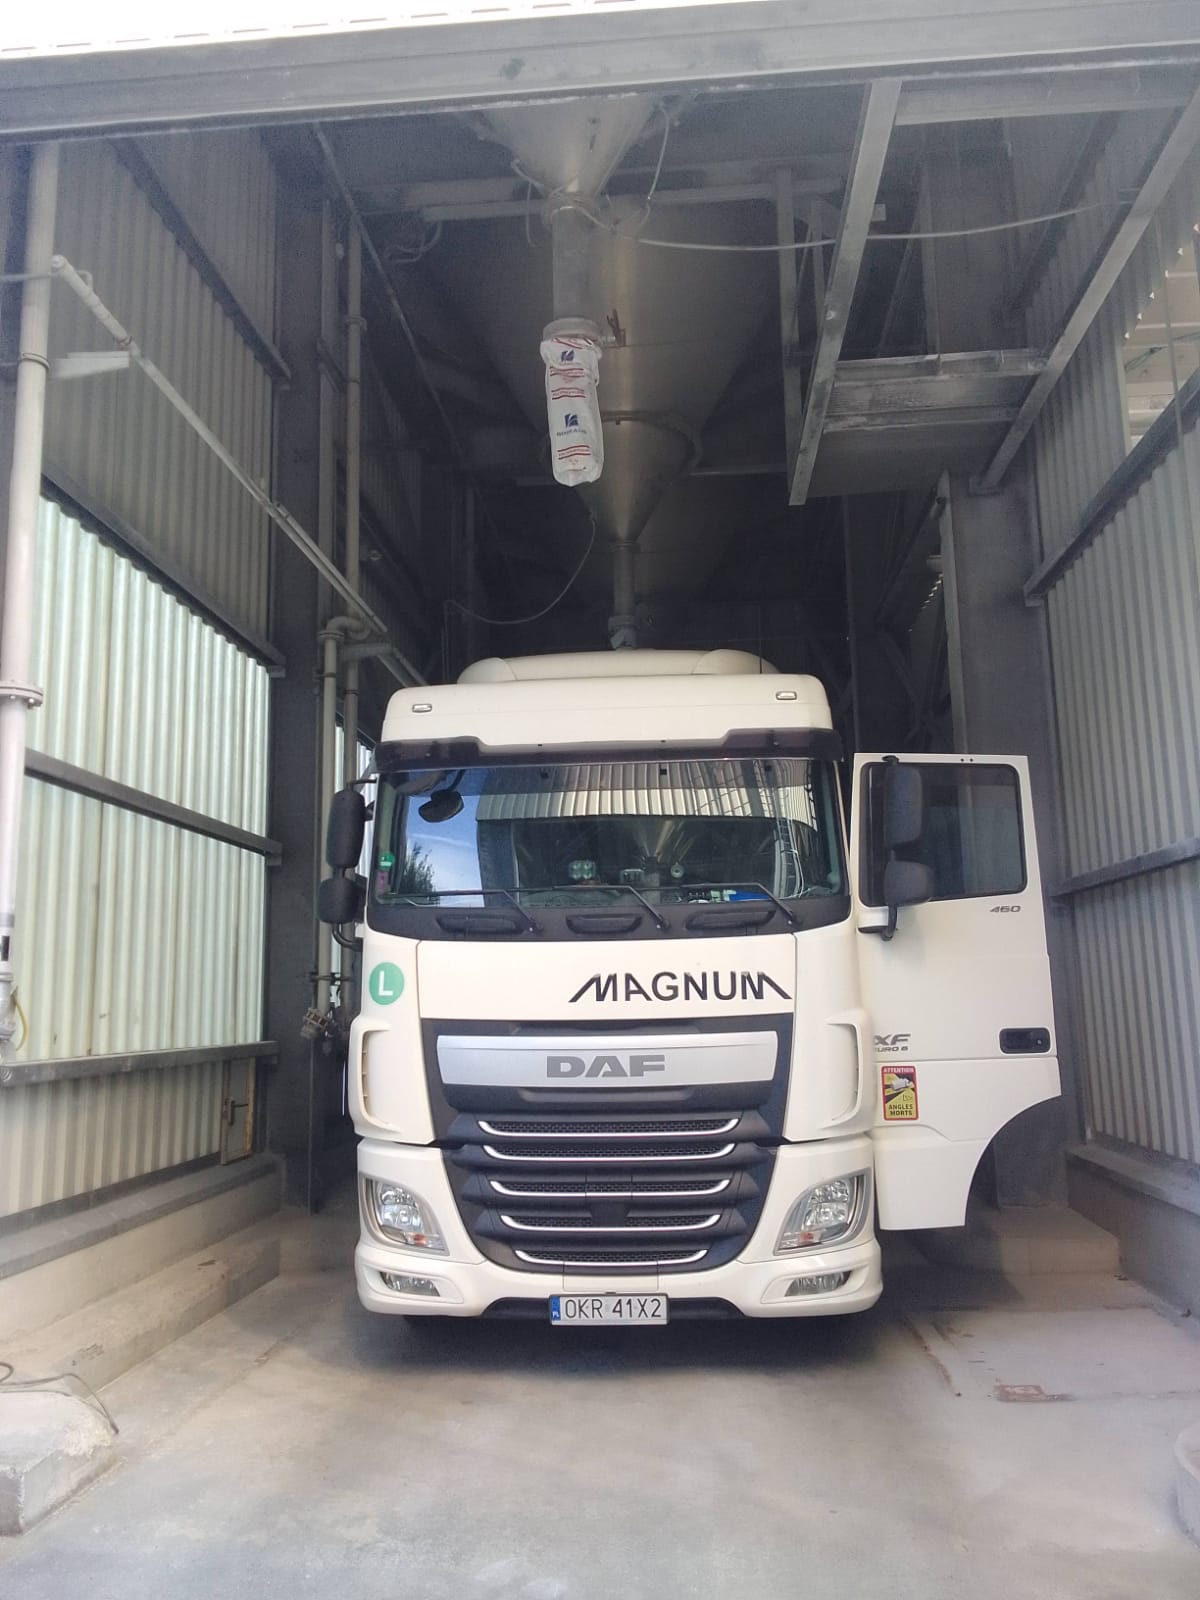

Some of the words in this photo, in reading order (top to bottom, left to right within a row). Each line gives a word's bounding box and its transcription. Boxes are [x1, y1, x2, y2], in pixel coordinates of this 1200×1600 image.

[378, 970, 394, 996] L
[568, 971, 793, 1003] MAGNUM
[874, 1034, 911, 1045] XF
[547, 1055, 665, 1078] DAF
[565, 1298, 603, 1319] OKR
[612, 1298, 662, 1319] 41X2
